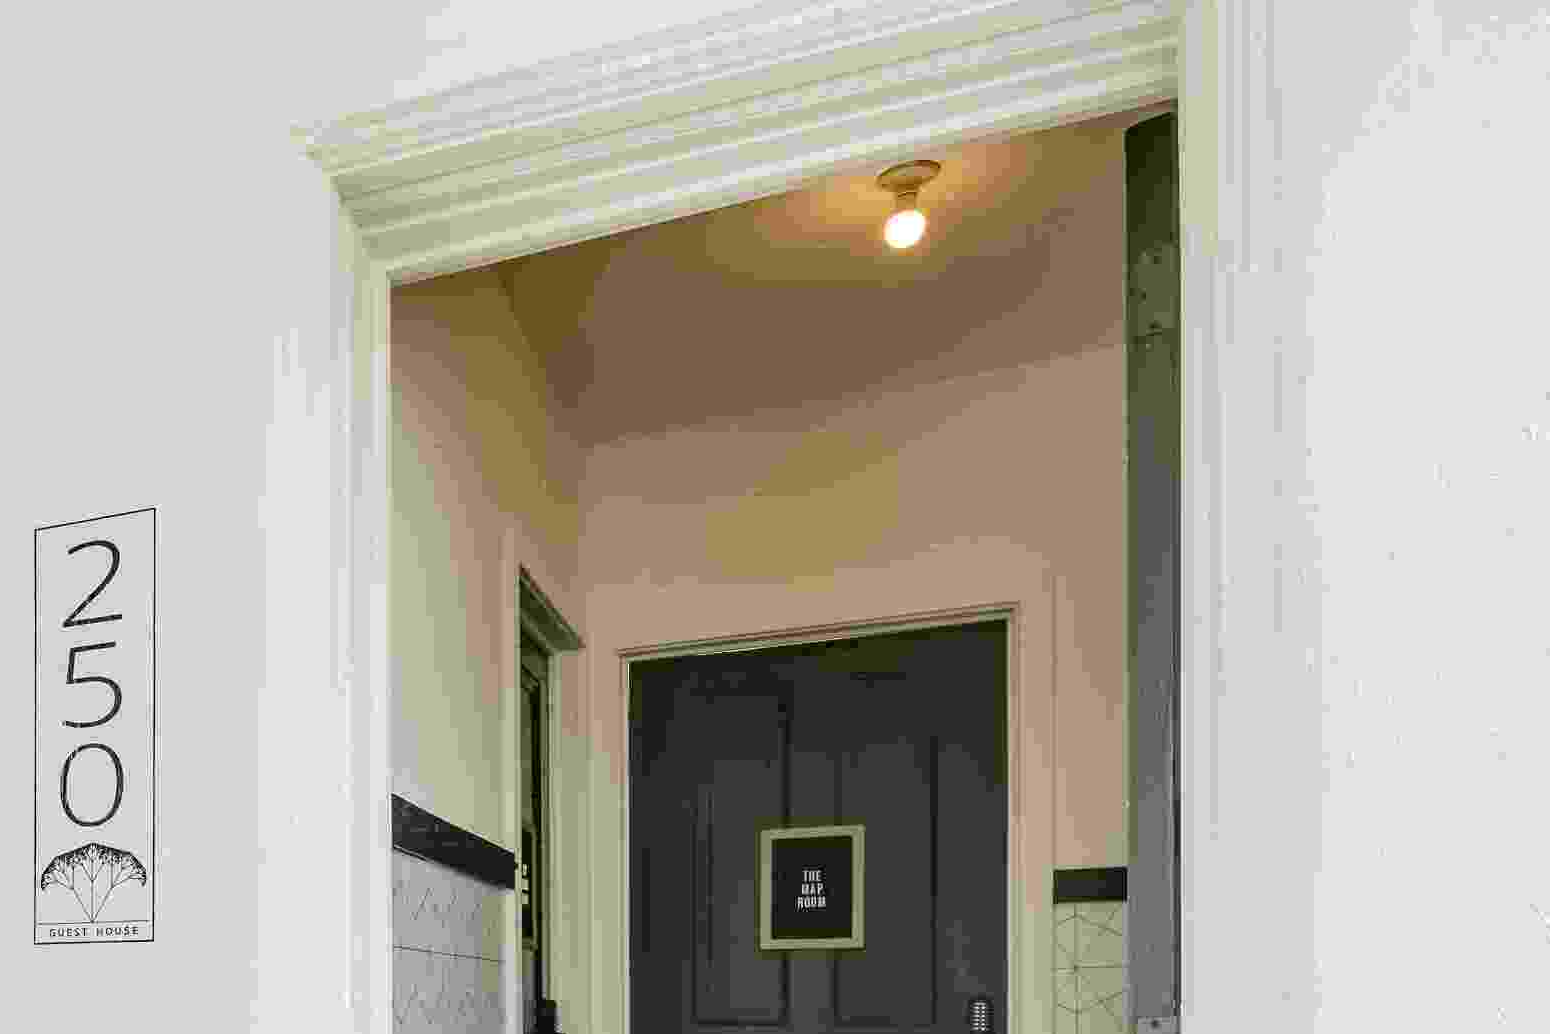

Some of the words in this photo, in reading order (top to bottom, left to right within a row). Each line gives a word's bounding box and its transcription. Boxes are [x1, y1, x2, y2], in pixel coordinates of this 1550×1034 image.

[59, 539, 124, 827] 250
[802, 869, 823, 882] THE
[801, 882, 824, 895] MAP
[796, 896, 827, 909] ROOM
[49, 927, 87, 937] GUEST
[96, 926, 139, 937] HOUSE
